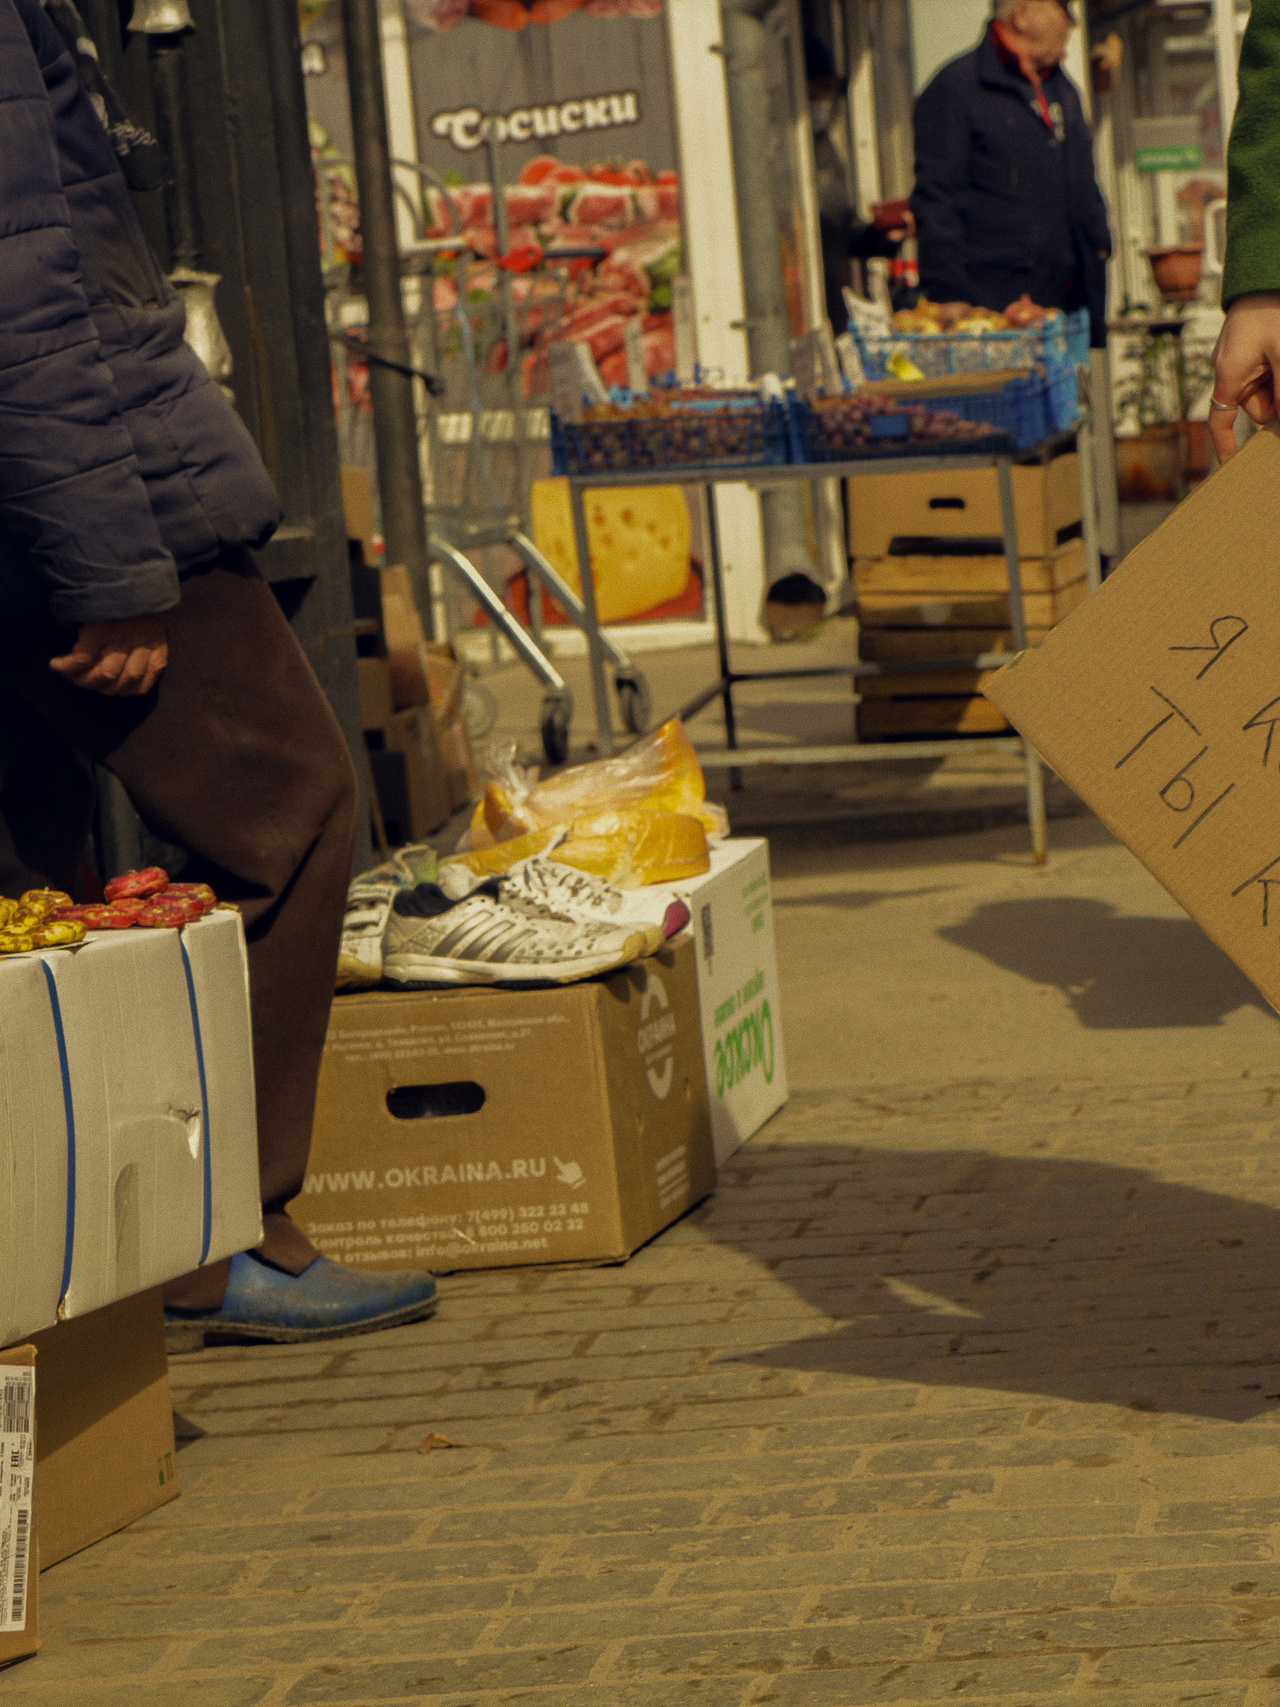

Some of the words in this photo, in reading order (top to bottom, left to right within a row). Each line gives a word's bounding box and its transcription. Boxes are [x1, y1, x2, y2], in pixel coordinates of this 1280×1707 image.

[432, 91, 638, 150] Сосиски
[1168, 615, 1249, 680] Я
[1114, 685, 1235, 850] ТЫ
[302, 1157, 547, 1194] WWW.OKRAINA.RU
[357, 1220, 377, 1231] по
